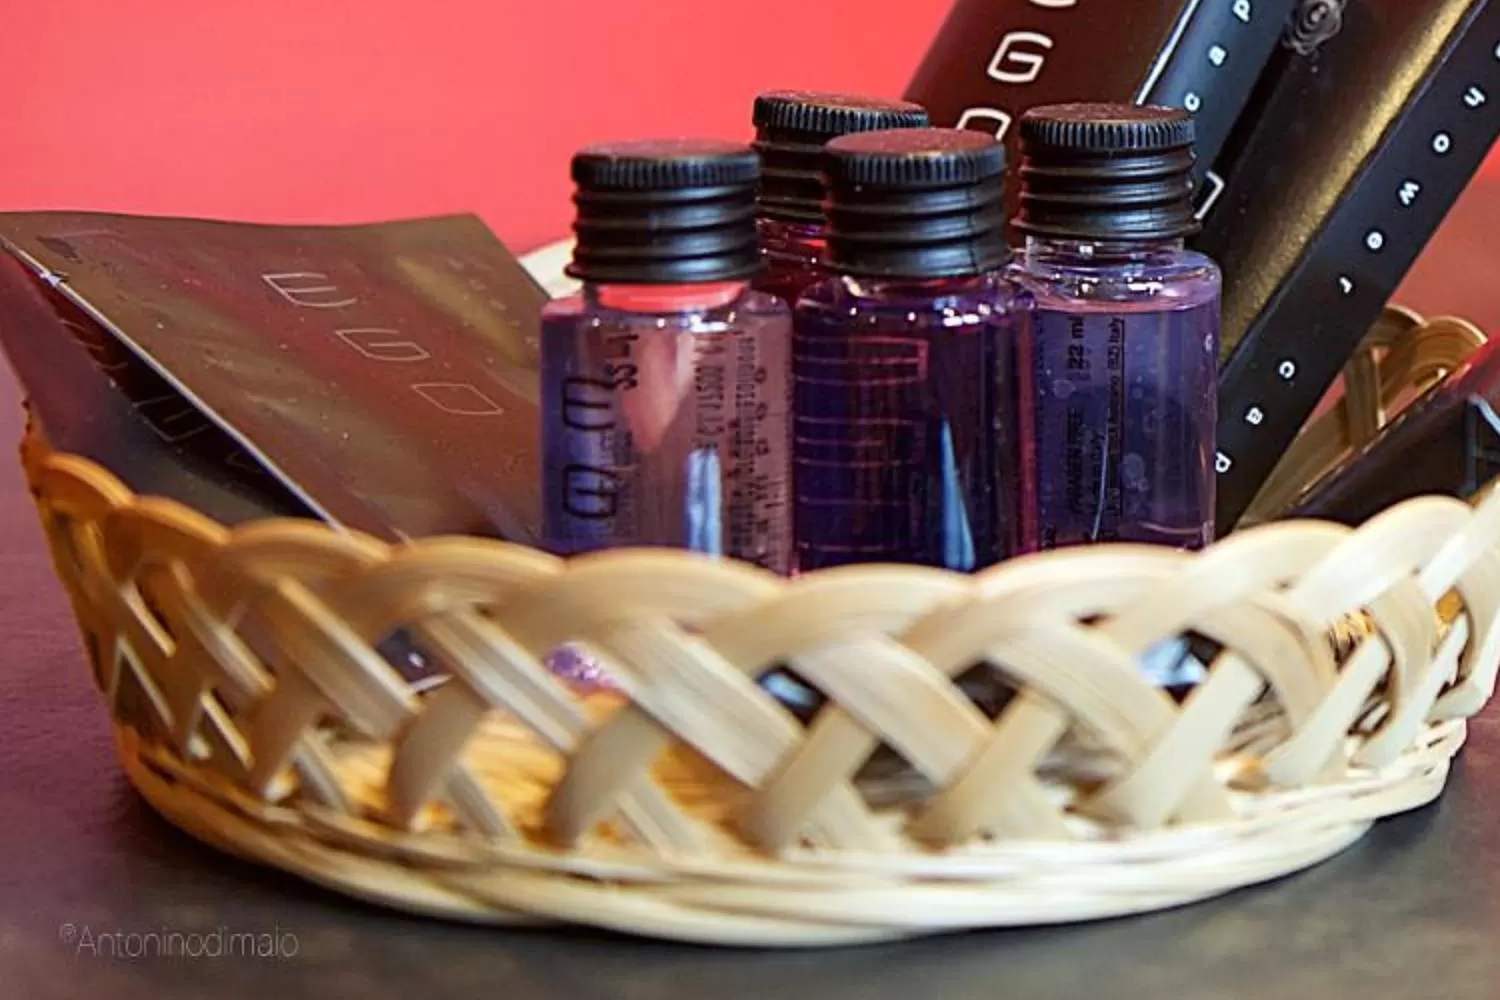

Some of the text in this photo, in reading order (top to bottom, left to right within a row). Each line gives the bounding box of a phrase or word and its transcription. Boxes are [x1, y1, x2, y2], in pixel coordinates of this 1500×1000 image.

[1068, 316, 1085, 370] 22 ml
[562, 376, 618, 519] EG
[1215, 360, 1296, 473] cap
